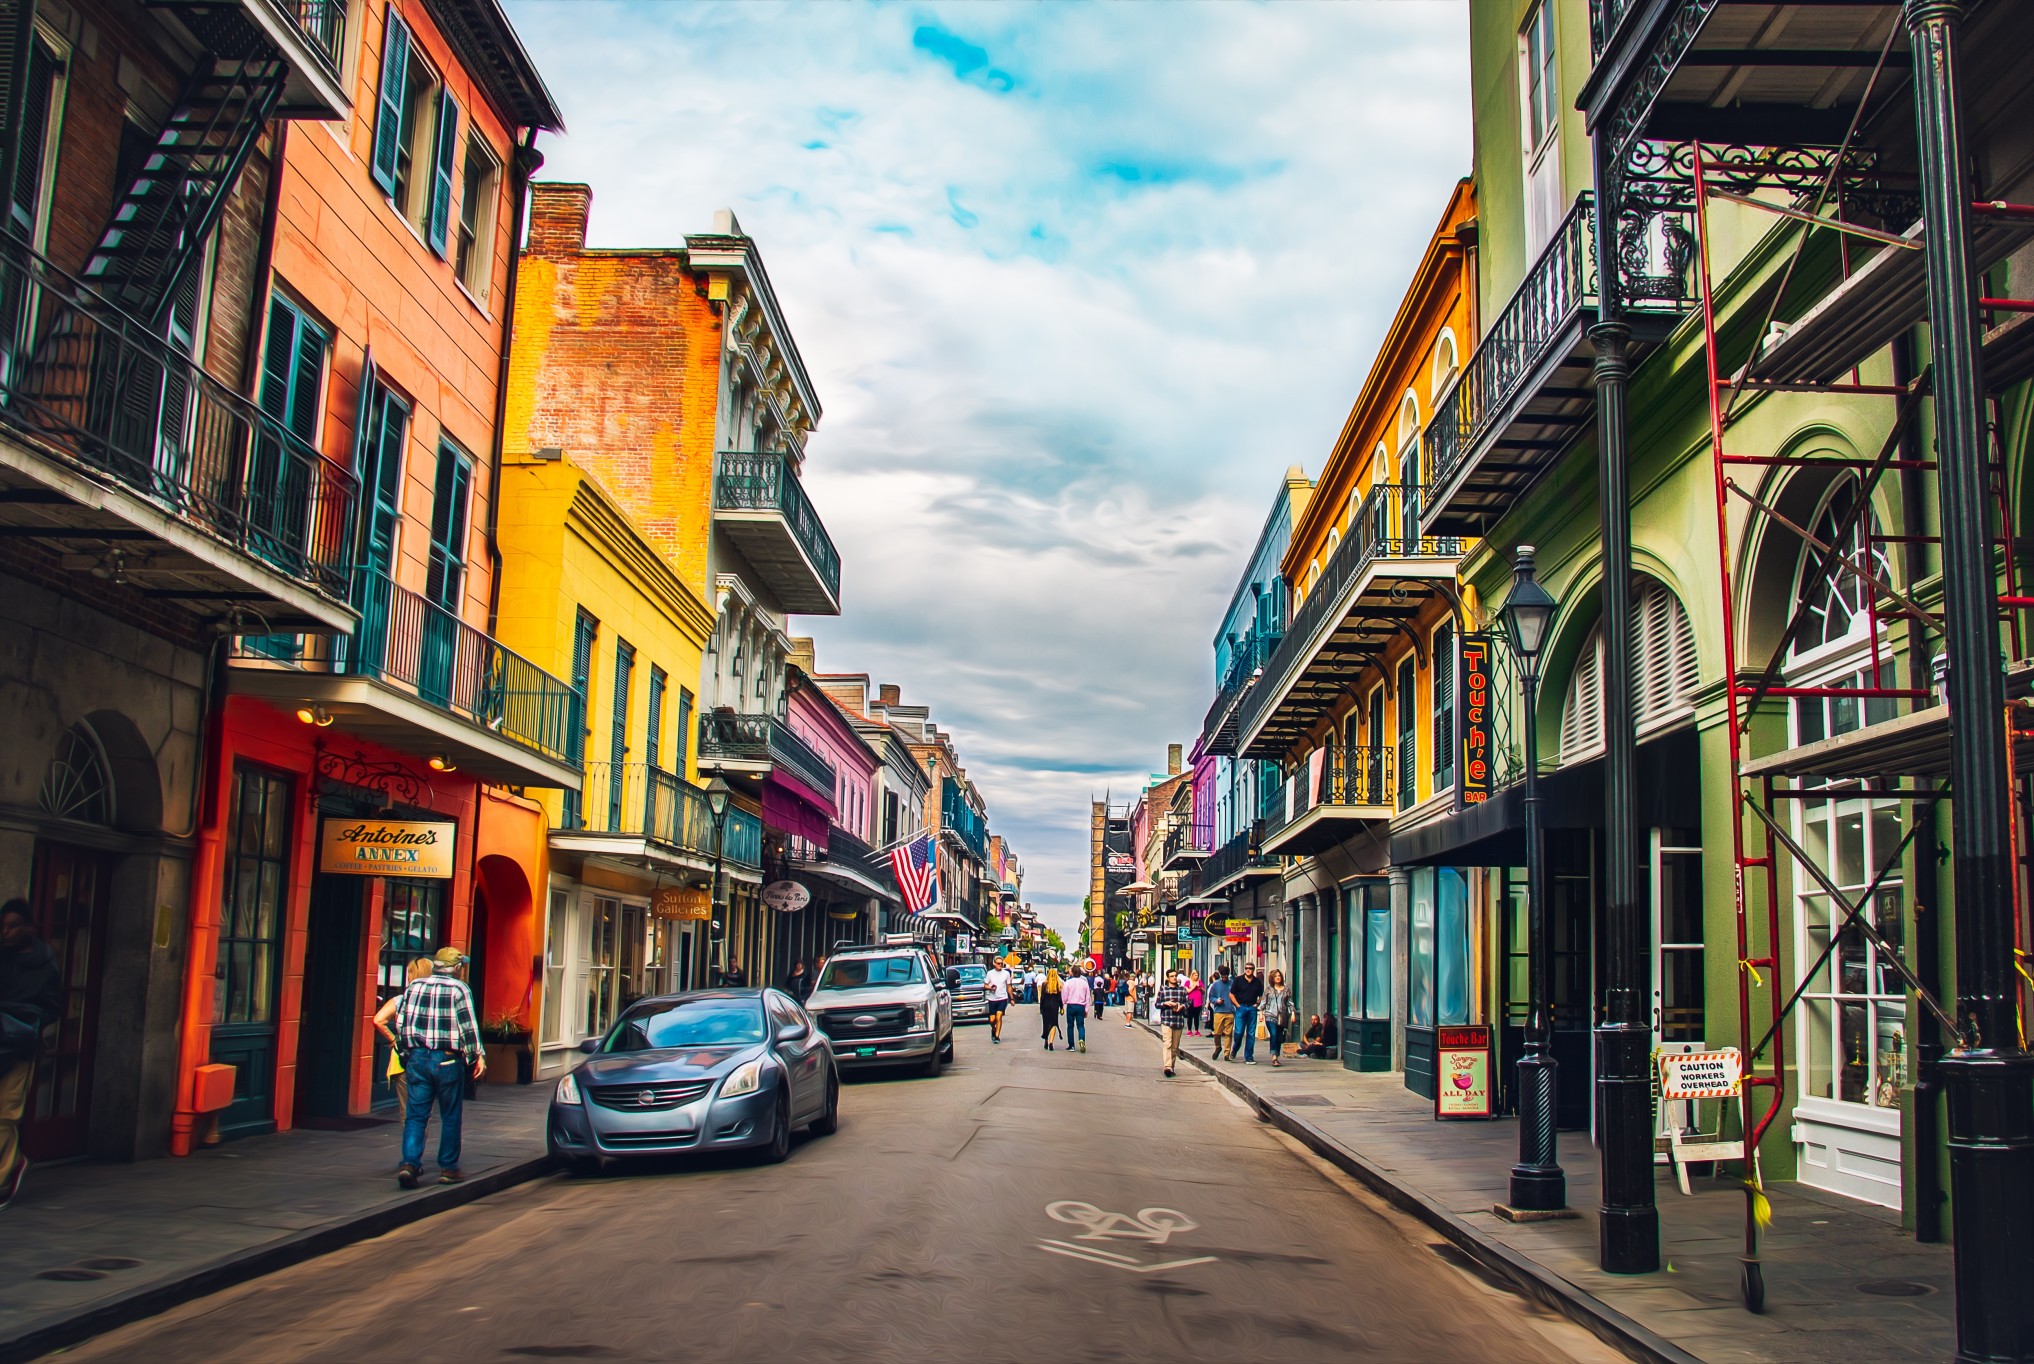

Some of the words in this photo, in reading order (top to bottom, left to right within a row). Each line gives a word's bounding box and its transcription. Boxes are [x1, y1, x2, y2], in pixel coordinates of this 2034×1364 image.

[1464, 791, 1487, 803] BAR
[336, 825, 438, 845] Antoine's
[357, 846, 418, 862] ANNEX
[368, 863, 402, 872] PASTRIES
[407, 865, 438, 873] GELATO
[663, 892, 701, 904] Sutton
[656, 902, 707, 915] Galleries
[1470, 1031, 1487, 1045] Bar
[1680, 1062, 1724, 1072] CAUTION
[1681, 1072, 1725, 1081] WORKERS
[1681, 1080, 1729, 1090] OVERHEAD
